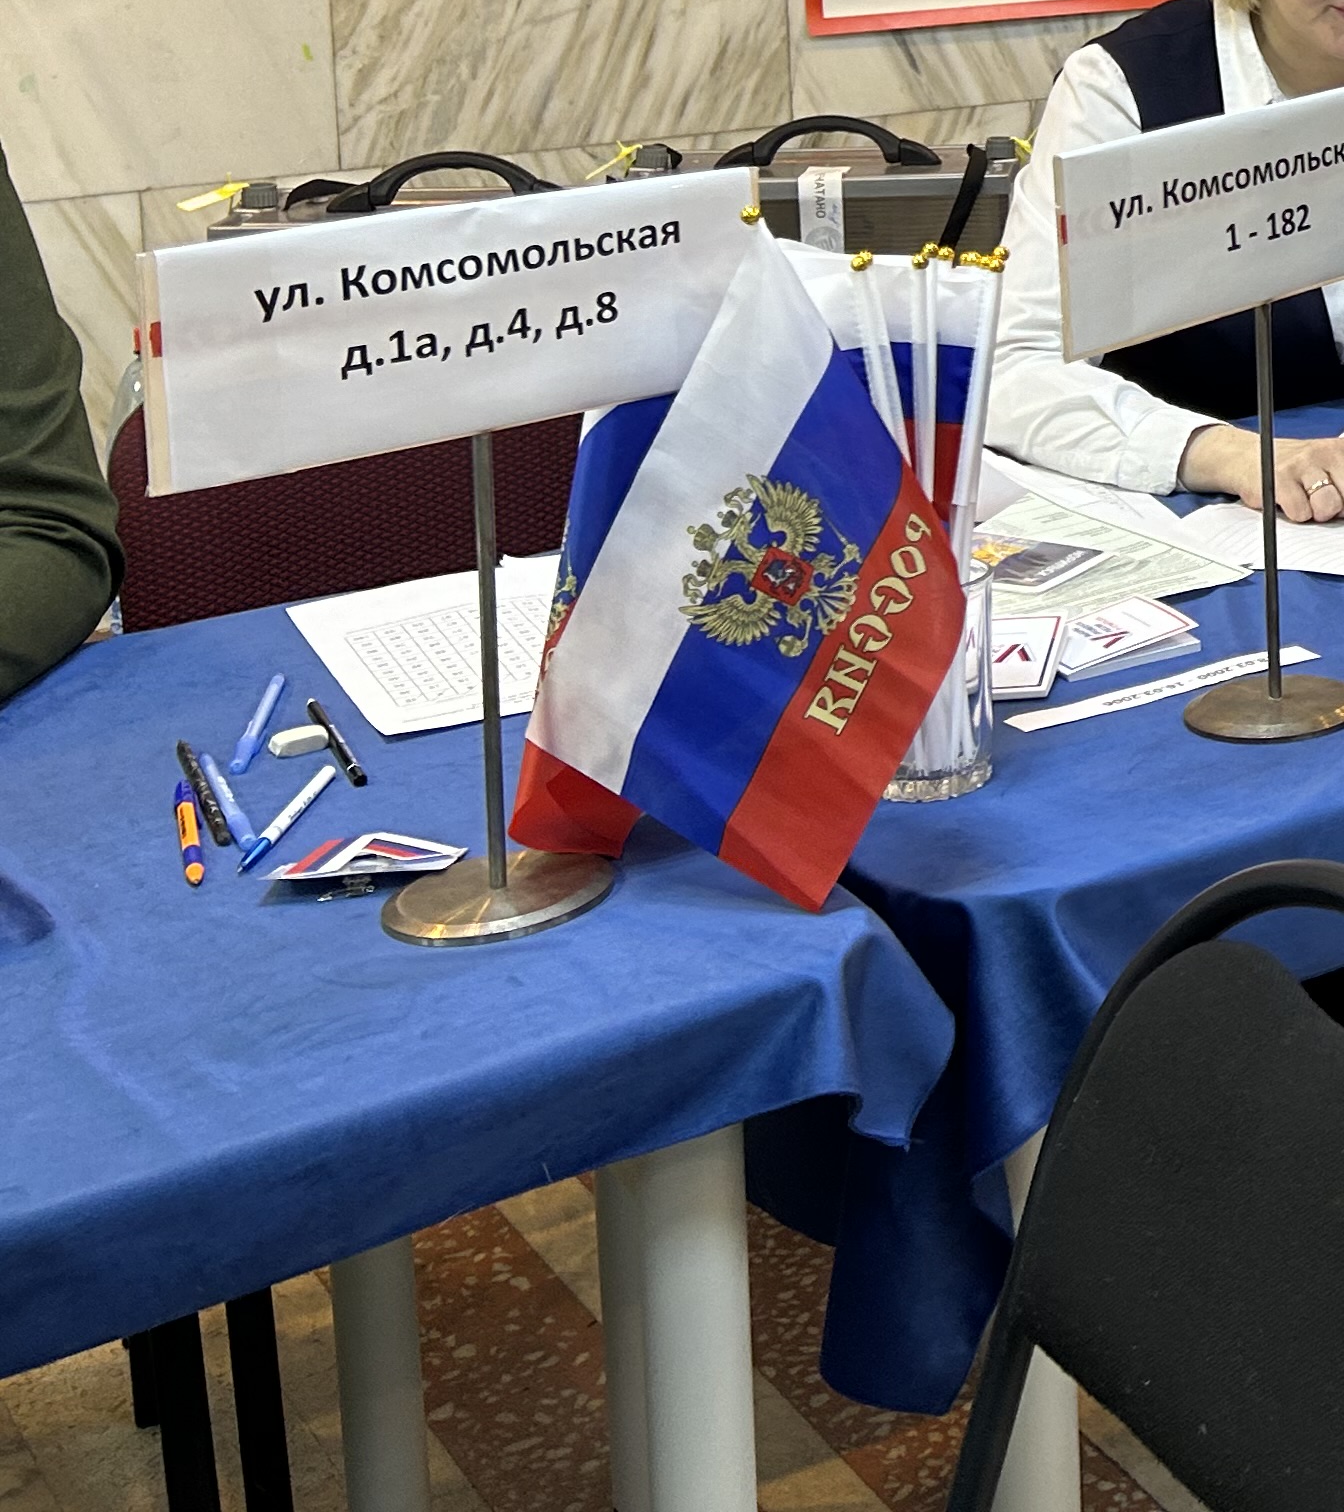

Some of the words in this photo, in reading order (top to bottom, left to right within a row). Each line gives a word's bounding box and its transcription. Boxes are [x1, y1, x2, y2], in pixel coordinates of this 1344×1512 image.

[1109, 196, 1153, 229] ул.
[1226, 224, 1241, 252] 1
[1267, 204, 1311, 240] 182
[254, 274, 325, 323] ул.
[340, 218, 682, 302] Комсомольская
[340, 331, 451, 380] д.1а,
[465, 307, 542, 358] д.4,
[555, 292, 619, 336] д.8
